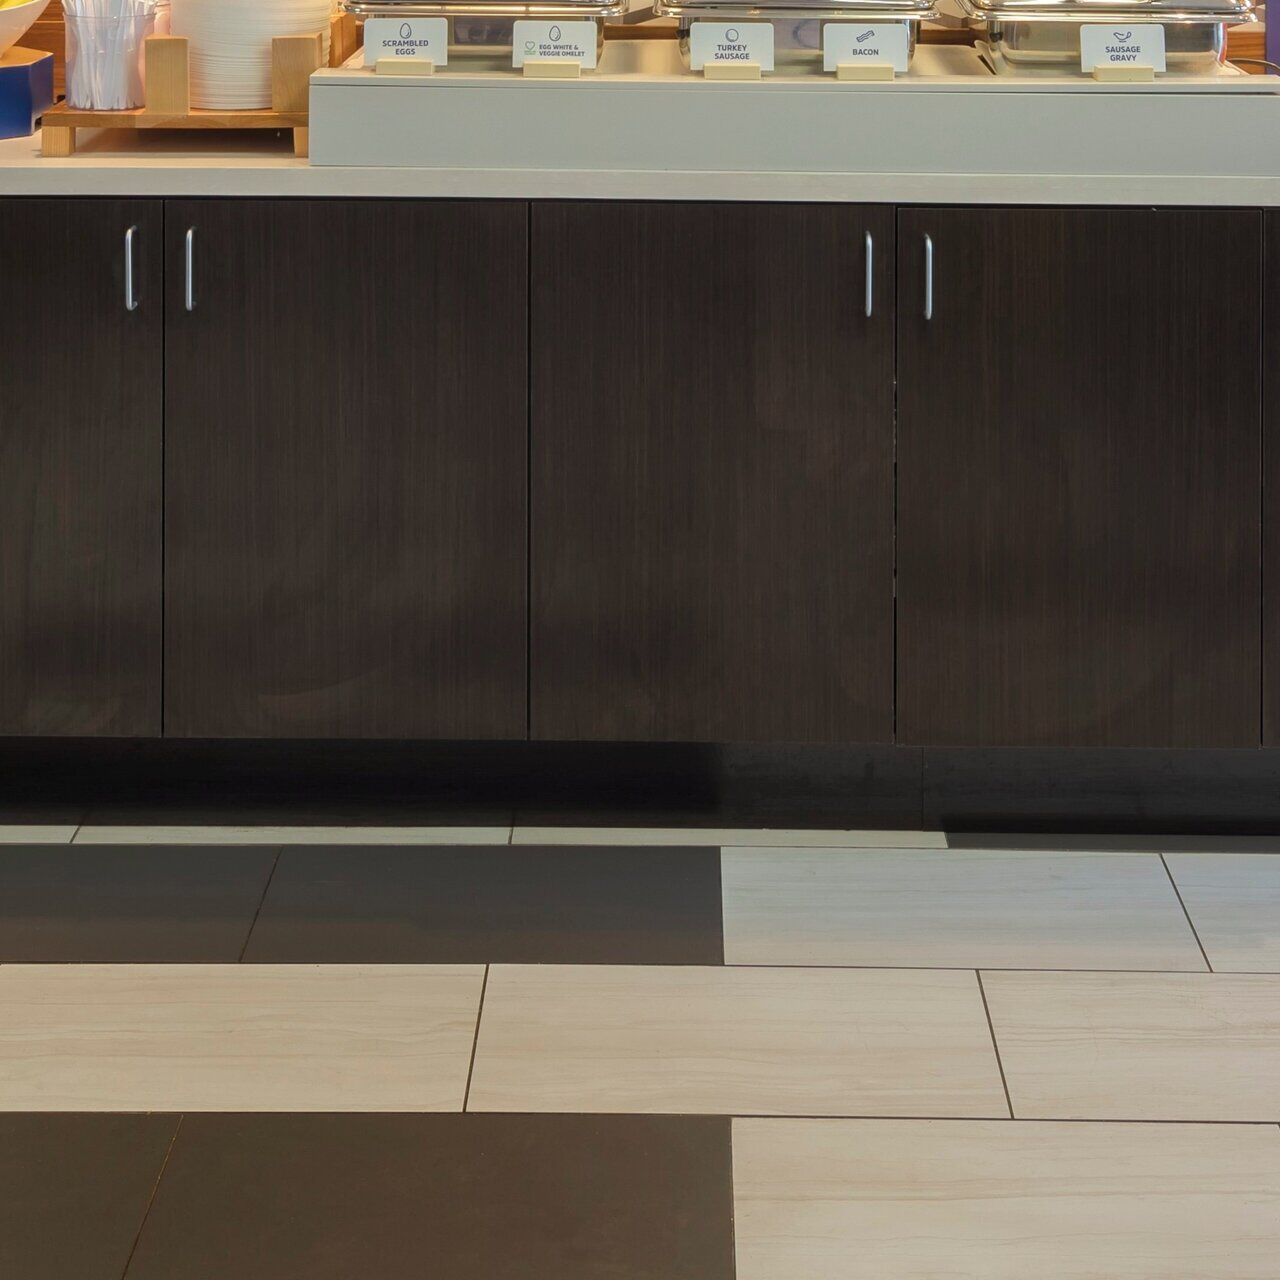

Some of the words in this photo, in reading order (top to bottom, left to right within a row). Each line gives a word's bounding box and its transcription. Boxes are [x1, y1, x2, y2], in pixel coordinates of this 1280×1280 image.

[382, 39, 429, 47] SCRAMBLED
[395, 48, 416, 56] EGGS
[716, 44, 747, 52] TURKEY
[852, 48, 879, 56] BACON
[714, 52, 750, 60] SAUSAGE
[1110, 54, 1137, 62] GRAVY
